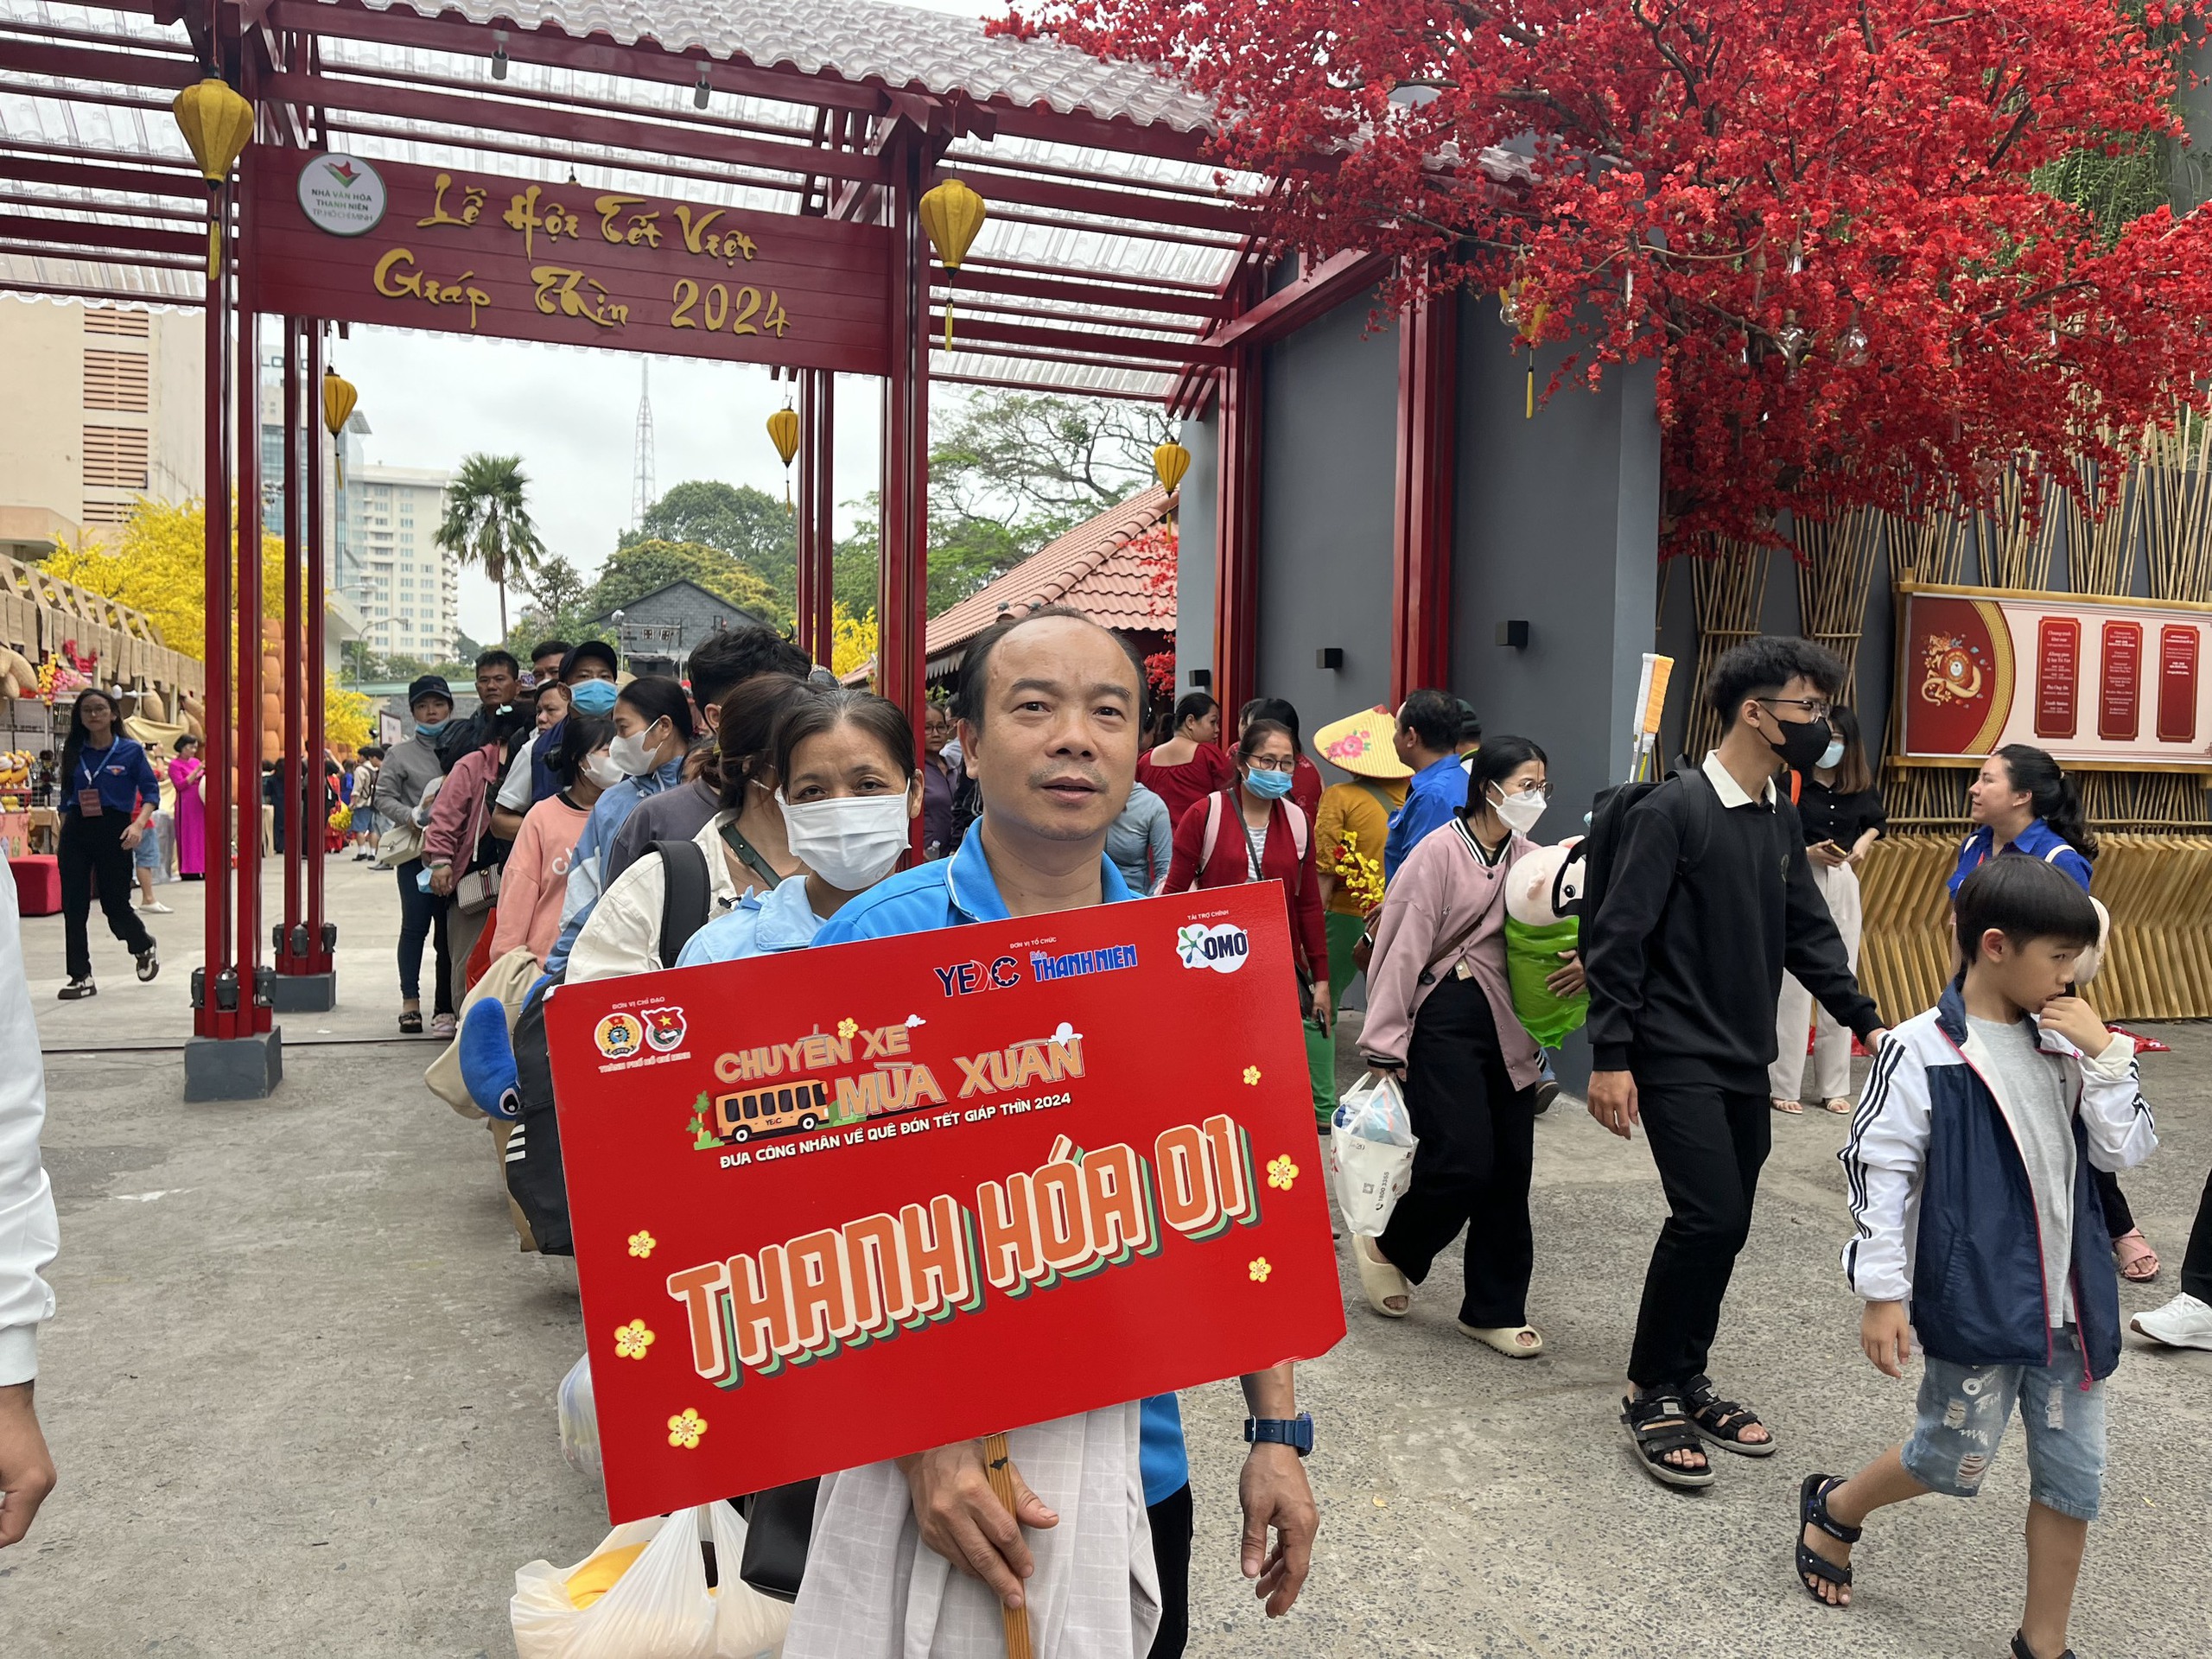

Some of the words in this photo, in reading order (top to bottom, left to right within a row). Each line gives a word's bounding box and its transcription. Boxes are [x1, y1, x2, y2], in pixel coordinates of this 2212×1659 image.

[316, 199, 347, 210] THANH
[416, 173, 486, 228] Lễ
[502, 185, 579, 264] Hội
[594, 195, 663, 248] Tết
[673, 205, 758, 267] Việt
[373, 248, 491, 329] Giáp
[531, 265, 628, 327] Thìn
[671, 278, 791, 338] 2024
[1031, 950, 1095, 982] THANH
[1095, 944, 1138, 973] NIÊN
[1205, 932, 1248, 960] OMO
[714, 1023, 854, 1084] CHUYẾN
[859, 1023, 911, 1060] XE
[836, 1062, 948, 1120] MÙA
[952, 1037, 1085, 1099] XUÂN
[720, 1151, 752, 1169] ĐƯA
[755, 1143, 797, 1162] CÔNG
[799, 1135, 841, 1154] NHÂN
[846, 1126, 864, 1146] VỀ
[868, 1122, 897, 1142] QUÊ
[900, 1116, 931, 1135] ĐÓN
[933, 1109, 961, 1130] TẾT
[964, 1104, 996, 1122] GIÁP
[1000, 1096, 1032, 1115] THÌN
[1034, 1092, 1071, 1110] 2024
[667, 1194, 985, 1389] THANH
[976, 1134, 1164, 1297] HÓA
